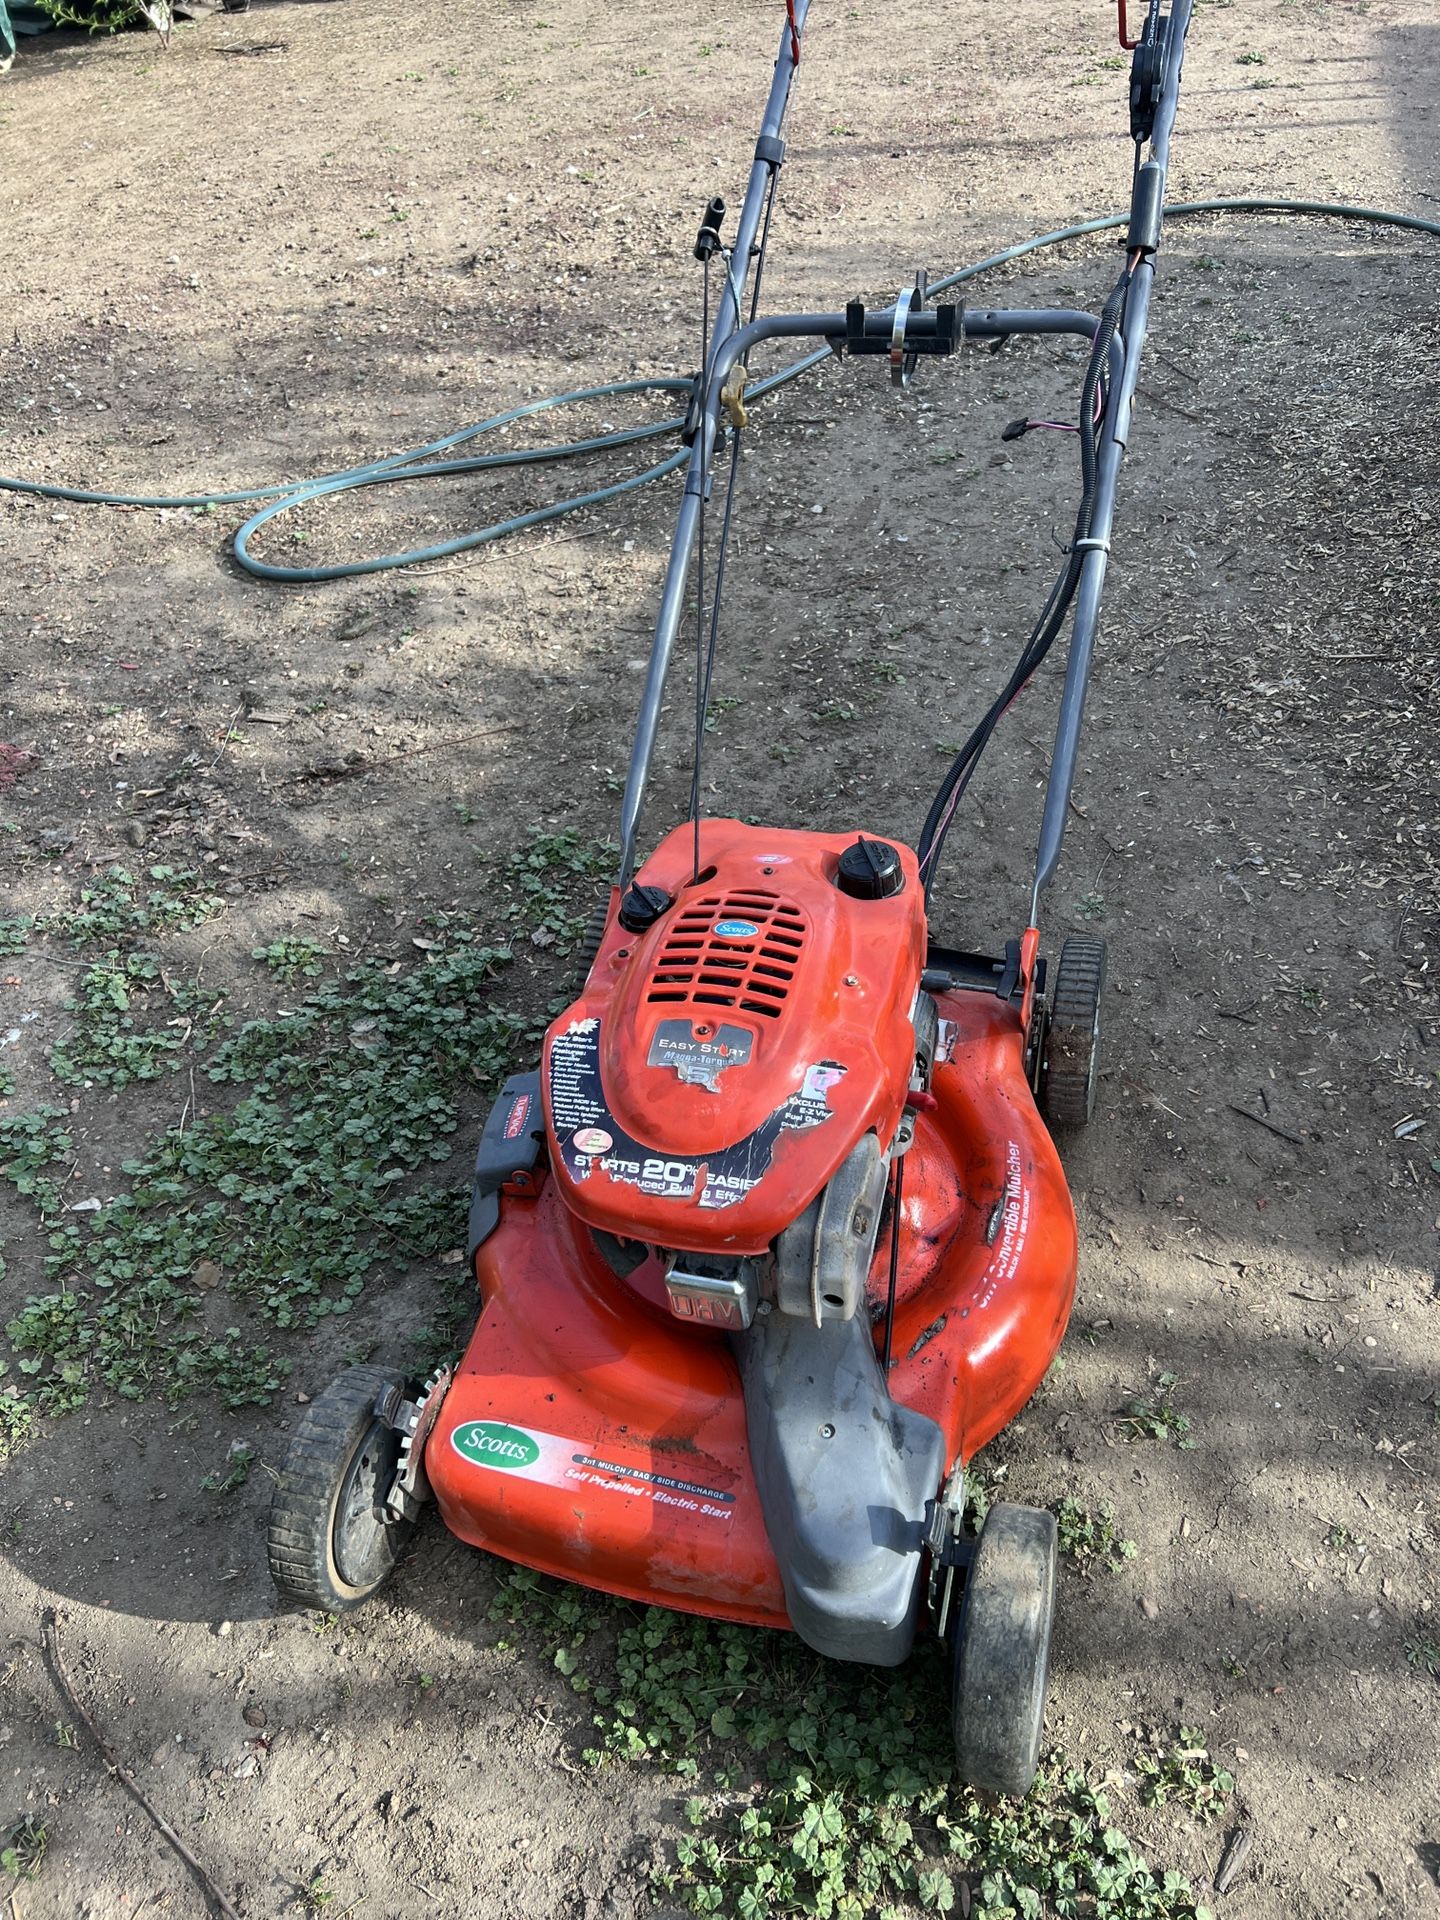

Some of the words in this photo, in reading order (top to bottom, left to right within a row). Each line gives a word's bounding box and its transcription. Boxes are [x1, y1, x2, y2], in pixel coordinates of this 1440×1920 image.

[552, 1040, 598, 1050] Performance
[572, 1036, 593, 1044] Start
[658, 1038, 696, 1051] EASY
[700, 1043, 746, 1057] STRT
[789, 1096, 826, 1110] EXCLUS
[784, 1112, 803, 1121] Fuel
[815, 1109, 829, 1117] Vie
[574, 1154, 640, 1174] STRTS
[642, 1158, 699, 1183] 20%
[706, 1172, 759, 1190] EASIE
[1007, 1140, 1021, 1199] Mulcher
[671, 1294, 738, 1325] OHV
[582, 1456, 596, 1466] 3n1
[598, 1461, 626, 1474] MULCH
[632, 1470, 650, 1482] BAG
[656, 1476, 676, 1488] SIDE
[677, 1481, 725, 1500] DISCHARGE
[564, 1468, 588, 1482] Self
[588, 1472, 645, 1497] Propelled
[652, 1490, 698, 1512] Electric
[700, 1504, 732, 1520] Start
